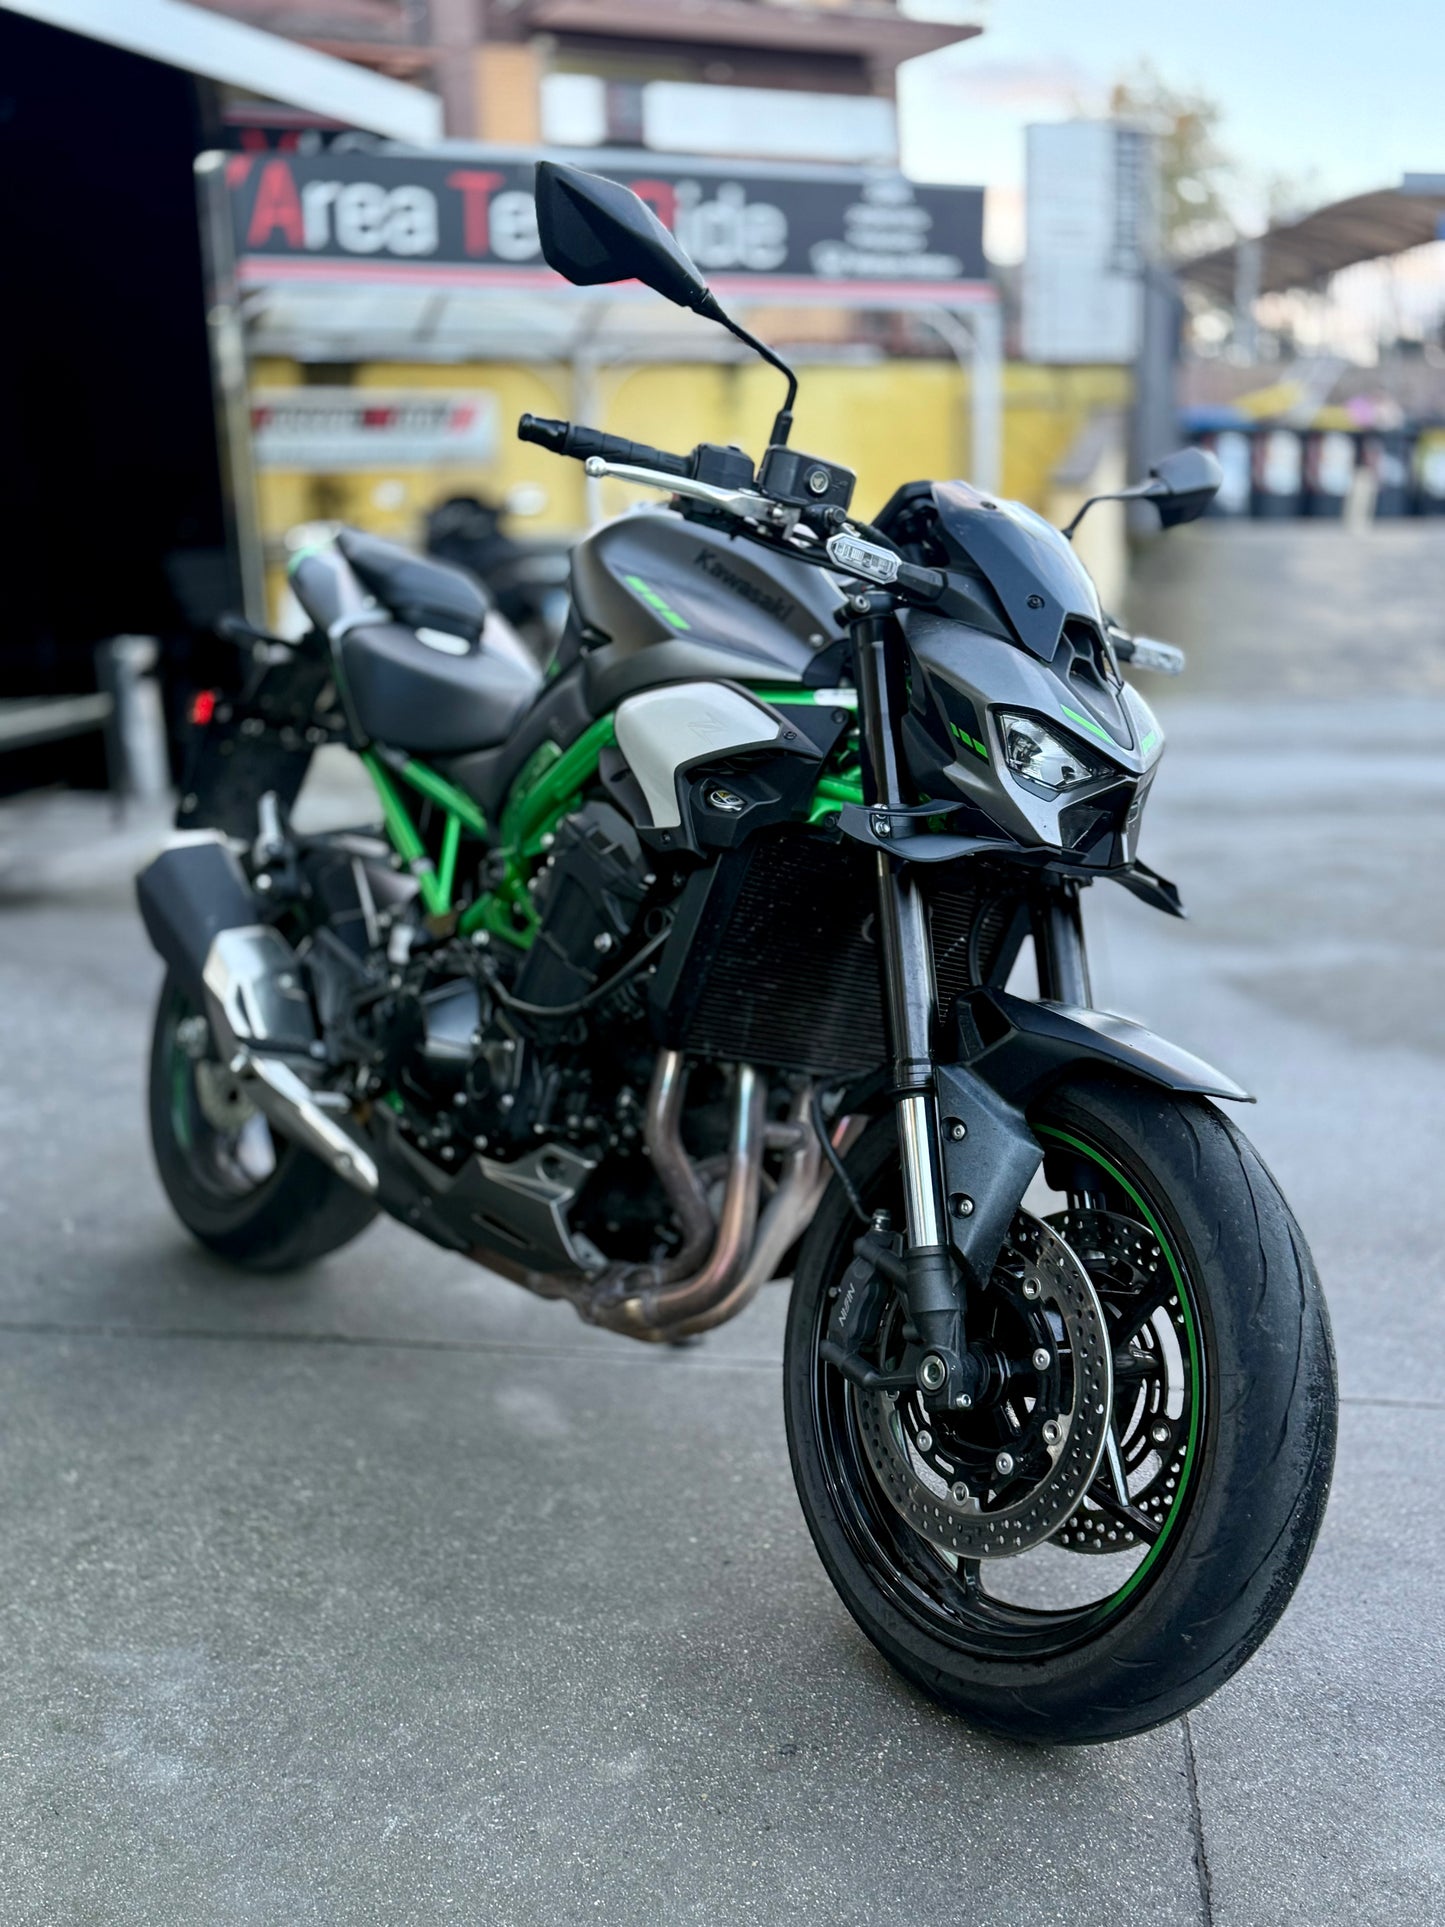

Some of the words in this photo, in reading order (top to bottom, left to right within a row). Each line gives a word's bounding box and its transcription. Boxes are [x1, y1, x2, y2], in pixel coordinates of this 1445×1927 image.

[246, 159, 439, 256] Area
[445, 168, 543, 262] Te
[694, 551, 794, 622] Kawasaki
